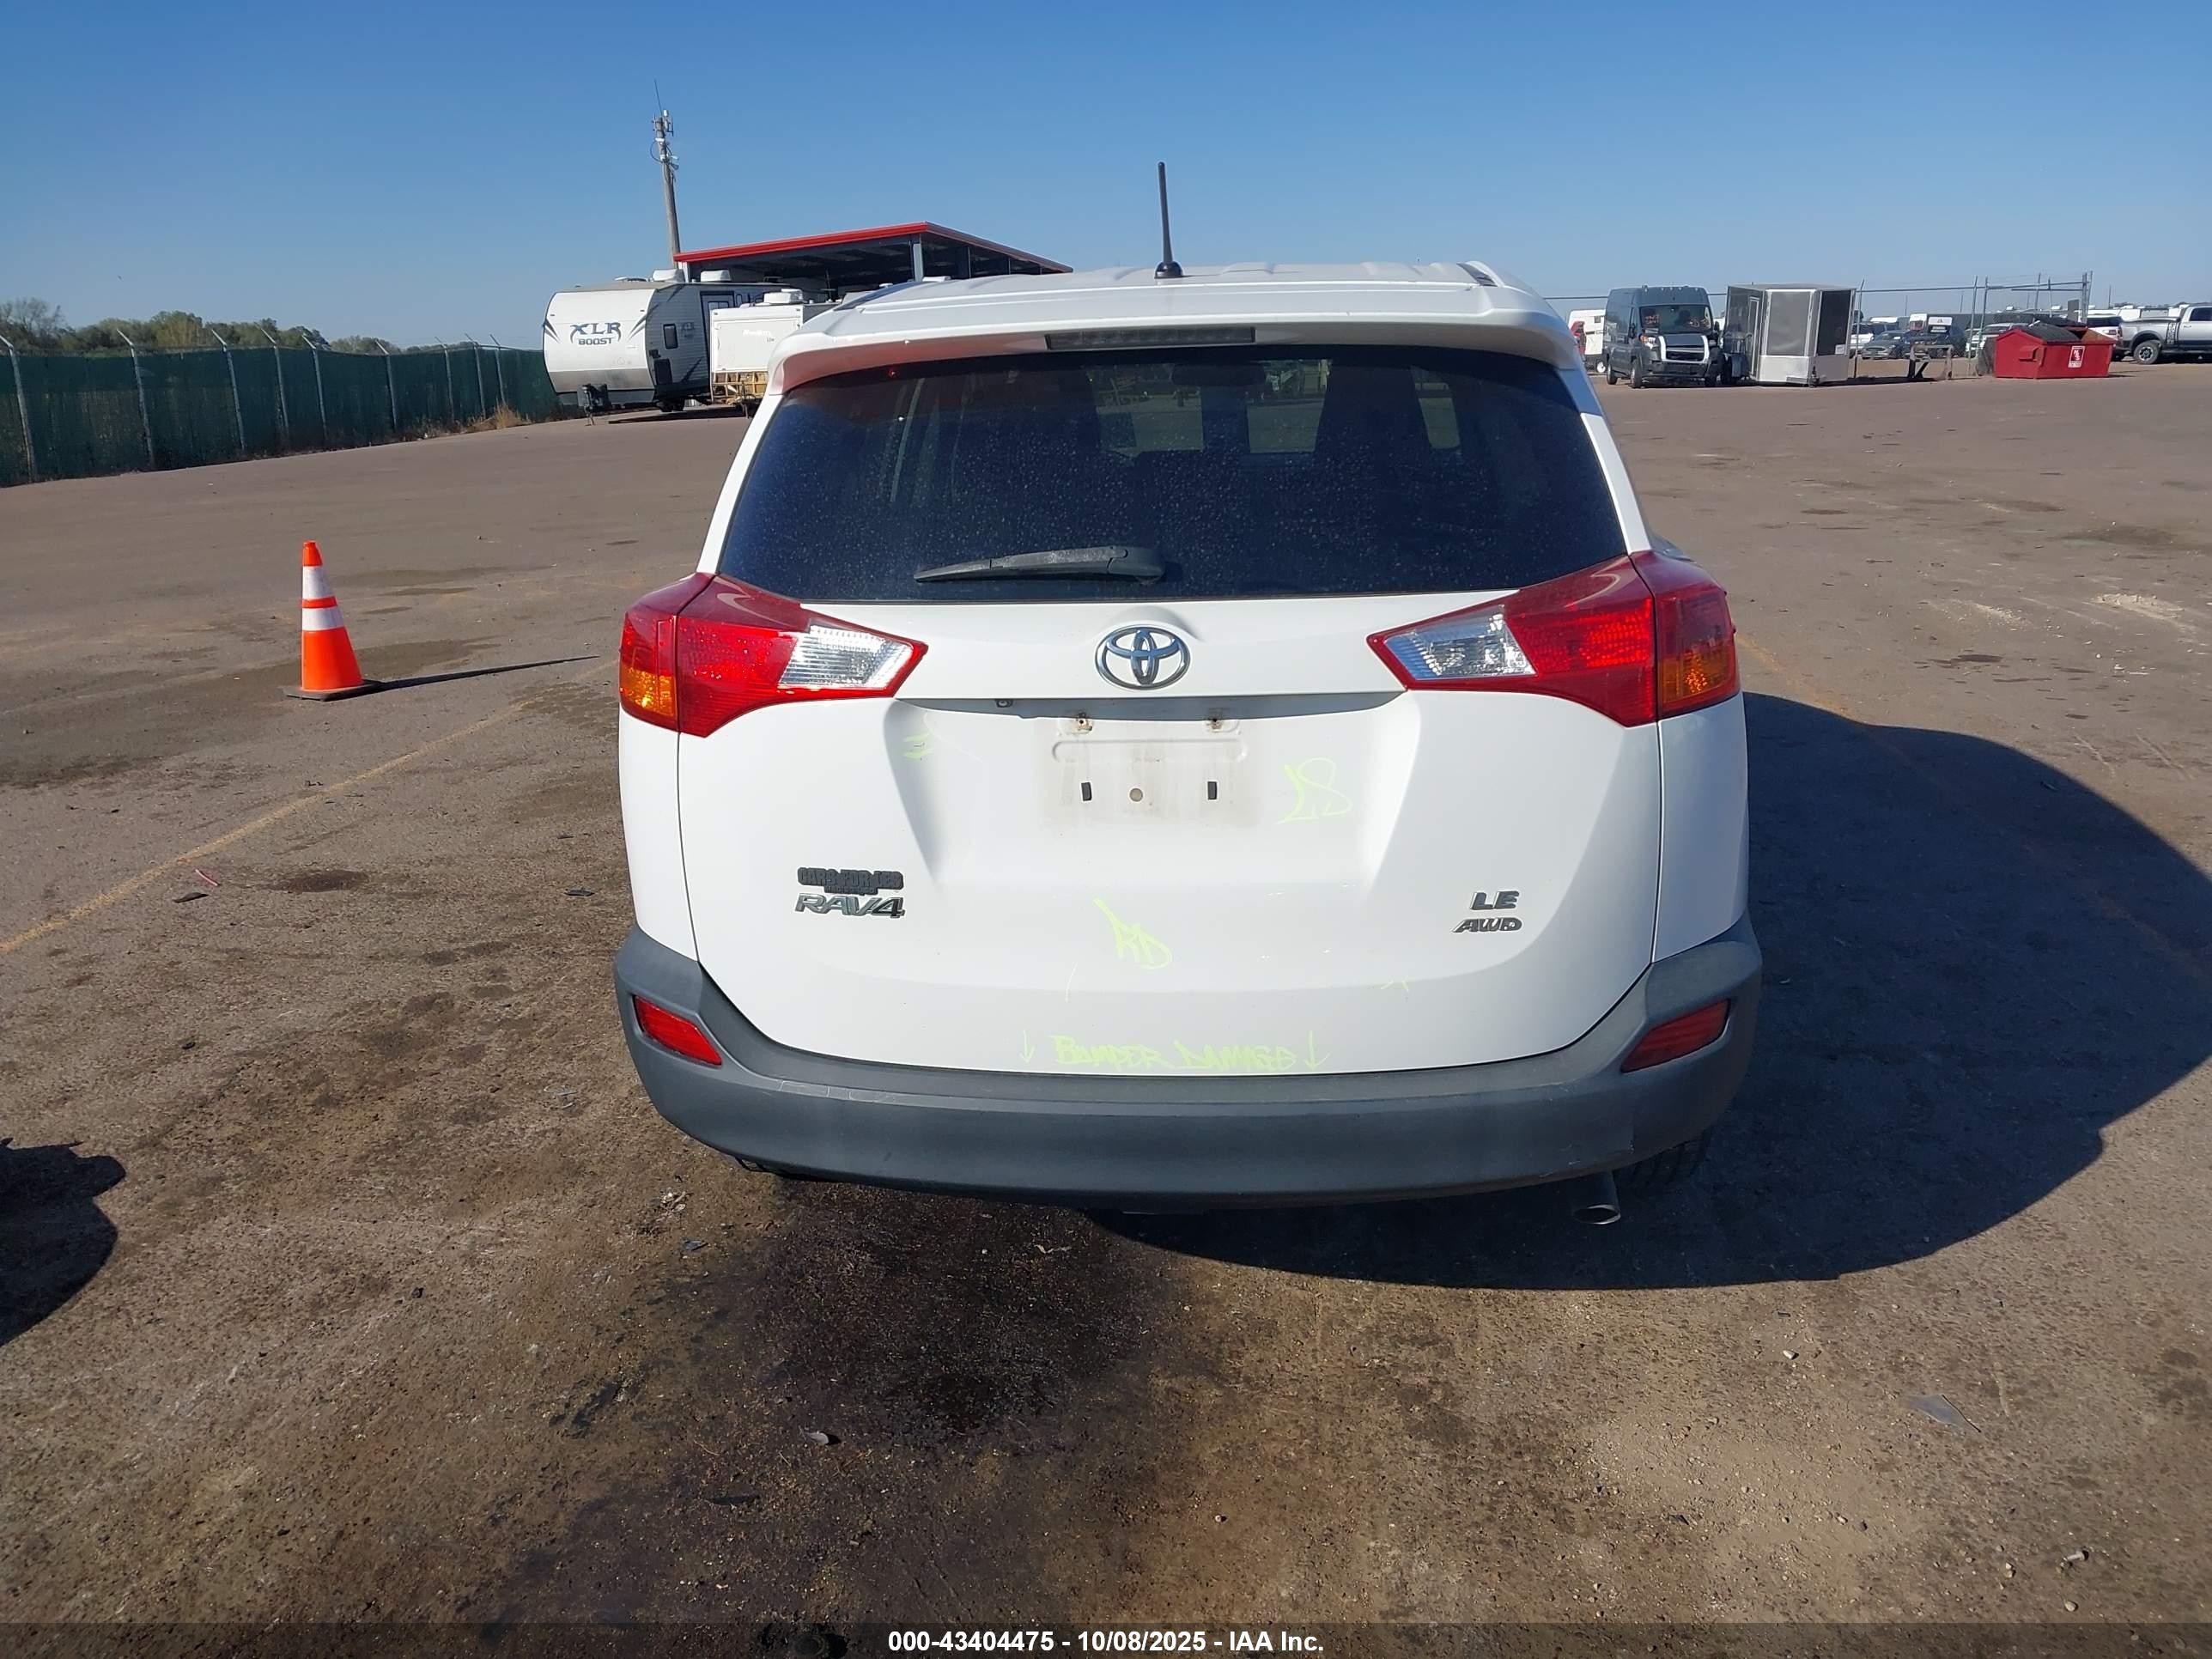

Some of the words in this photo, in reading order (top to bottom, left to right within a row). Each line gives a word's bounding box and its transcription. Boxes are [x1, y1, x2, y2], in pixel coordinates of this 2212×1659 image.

[569, 322, 622, 344] XLR
[795, 893, 905, 918] RAV4
[1469, 890, 1519, 910] LE
[1451, 917, 1522, 933] AWD
